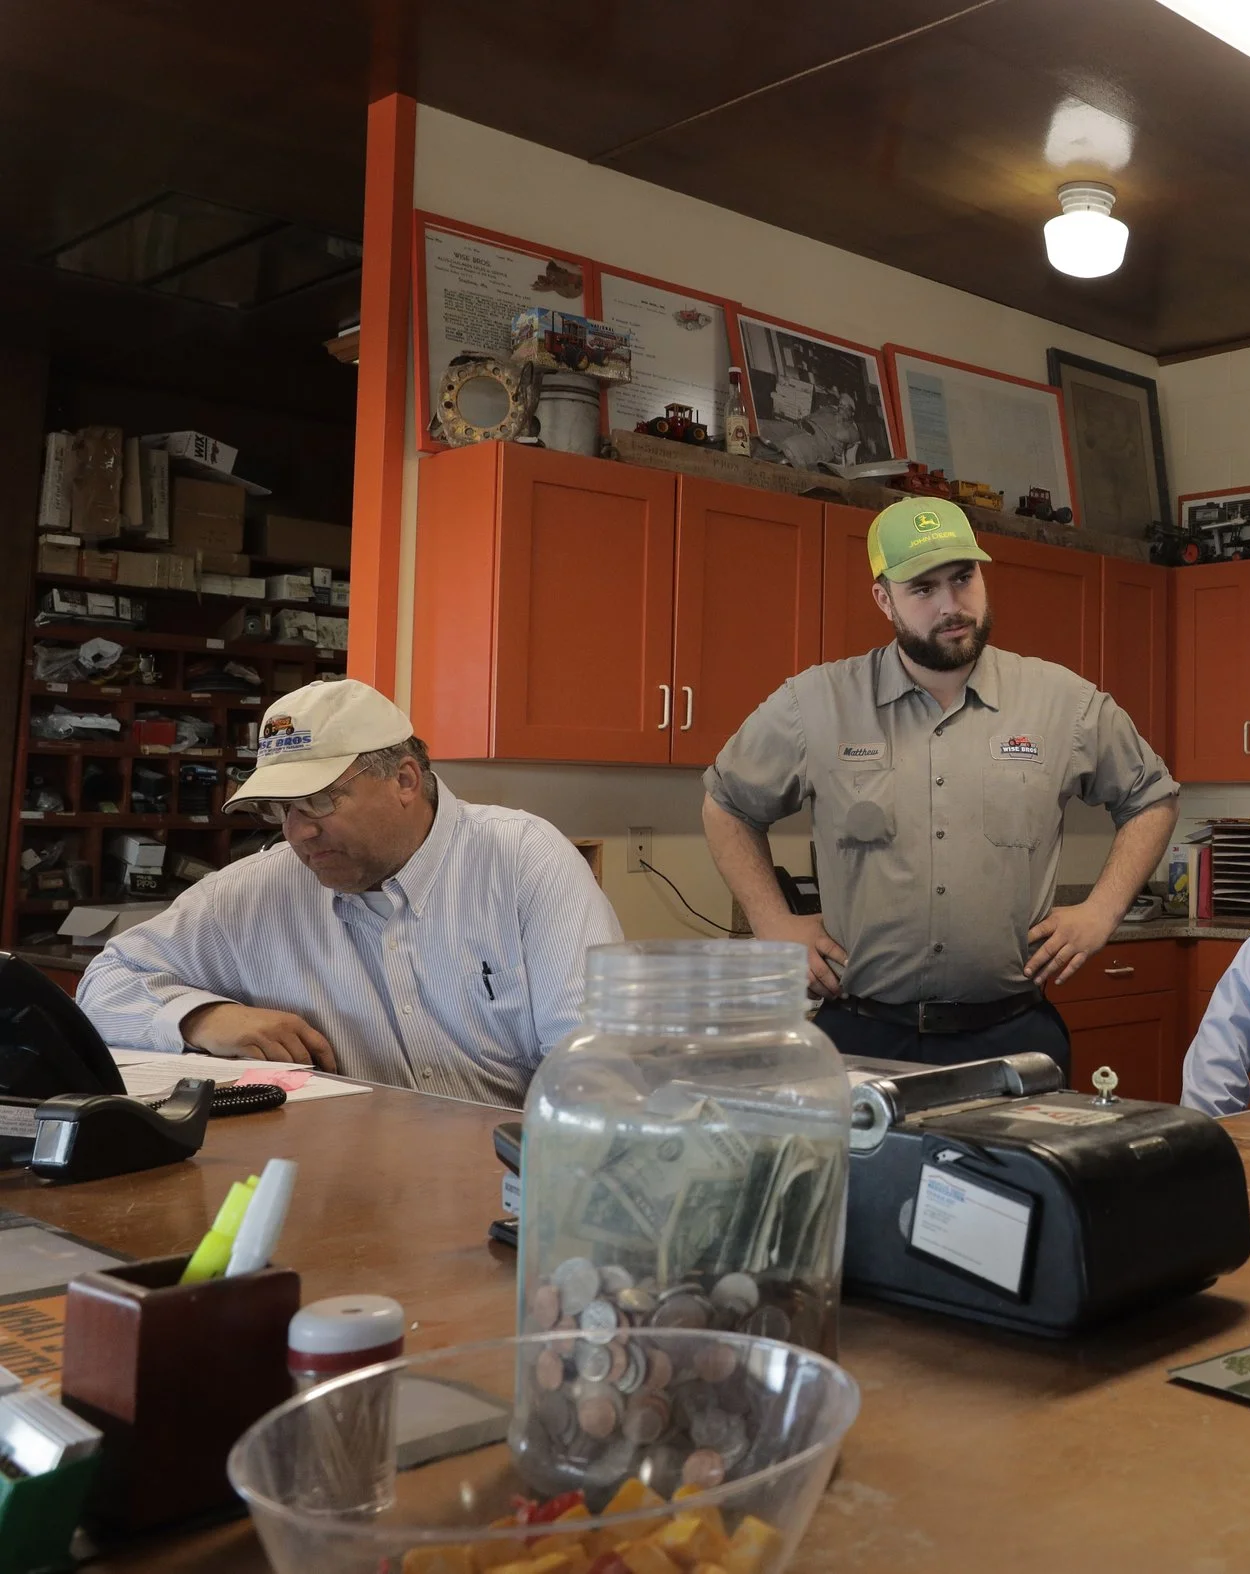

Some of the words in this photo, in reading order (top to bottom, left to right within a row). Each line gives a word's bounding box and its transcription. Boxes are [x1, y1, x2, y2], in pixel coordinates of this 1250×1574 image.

[195, 434, 205, 458] WIX
[908, 536, 932, 549] JOHN
[931, 531, 956, 543] DEERE
[276, 736, 311, 747] BROS
[843, 746, 878, 757] Matthew
[1003, 746, 1020, 754] WISE
[1021, 746, 1038, 754] BROS
[136, 880, 157, 889] Gold
